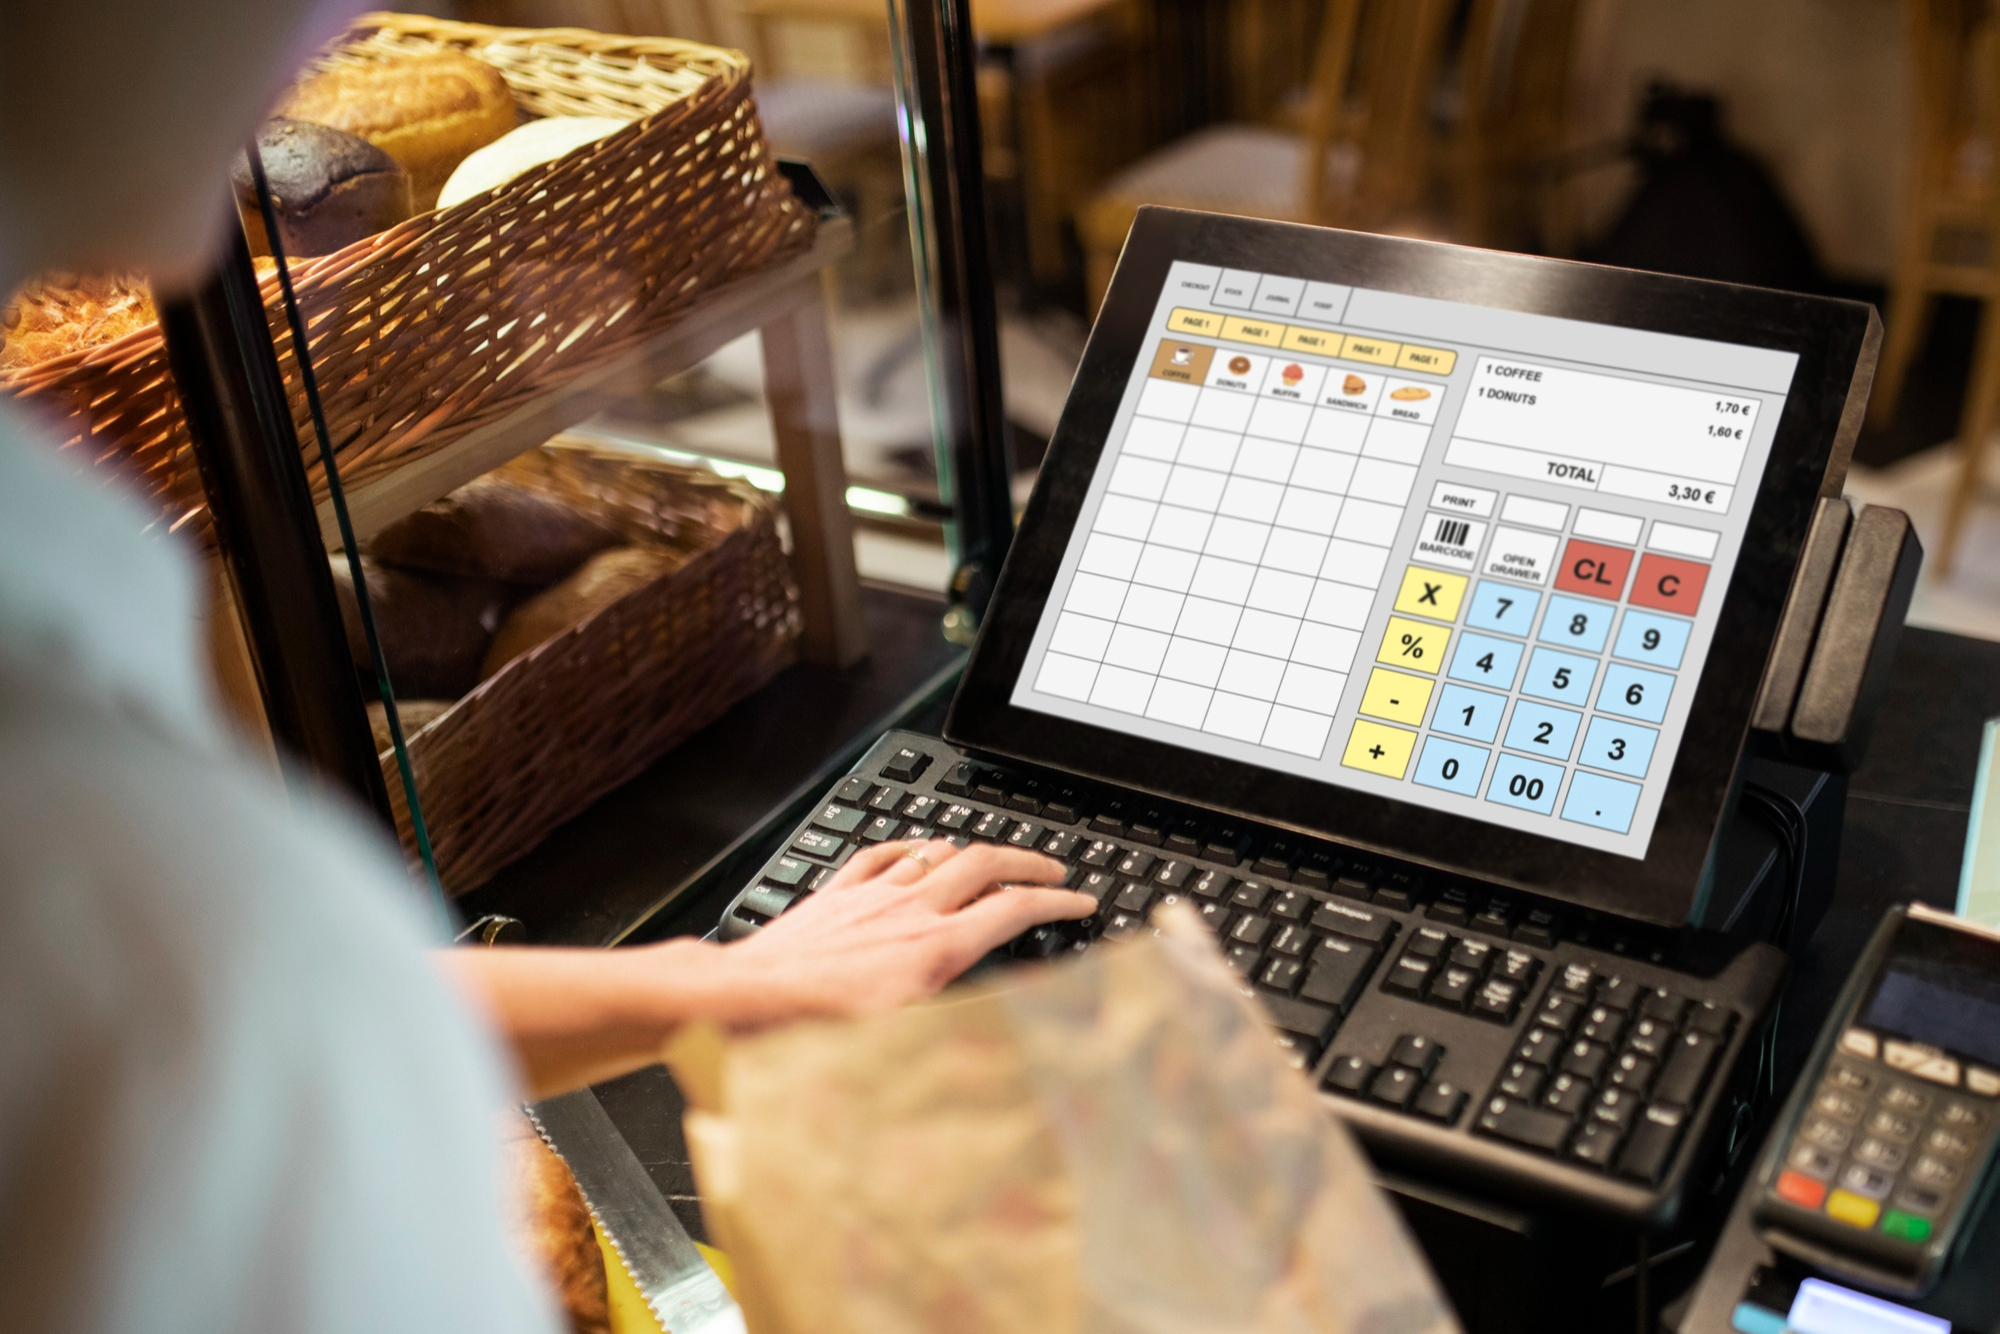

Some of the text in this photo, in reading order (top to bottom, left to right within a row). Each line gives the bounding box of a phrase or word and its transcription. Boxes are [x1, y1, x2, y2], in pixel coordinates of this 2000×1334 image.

[1181, 281, 1210, 290] CHECKOUT
[1224, 288, 1243, 296] STOCK
[1183, 317, 1210, 328] PAGE 1
[1242, 326, 1263, 336] PAGE
[1298, 335, 1326, 347] PAGE 1
[1353, 344, 1381, 356] PAGE 1
[1409, 353, 1439, 365] PAGE 1
[1162, 369, 1191, 380] COFFEE
[1487, 362, 1542, 382] 1 COFFEE
[1216, 379, 1247, 389] DONUTS
[1272, 388, 1300, 398] MUFFIN
[1479, 387, 1536, 405] 1 DONUTS
[1326, 397, 1367, 410] SANDWICH
[1716, 401, 1750, 415] 1,70 €
[1392, 409, 1420, 420] BREAD
[1708, 425, 1743, 439] 1,60 €
[1548, 462, 1595, 483] TOTAL
[1668, 484, 1715, 504] 3,30 €
[1442, 495, 1476, 508] PRINT
[1420, 542, 1474, 559] BARCODE
[1503, 554, 1536, 567] OPEN
[1490, 564, 1540, 582] DRAWER
[1573, 559, 1612, 585] CL
[1657, 575, 1680, 597] C
[1418, 582, 1441, 606] X
[1496, 598, 1513, 619] 7
[1569, 614, 1588, 636] 8
[1642, 629, 1661, 650] 9
[1401, 634, 1423, 659] %
[1476, 652, 1494, 673] 4
[1552, 667, 1571, 689] 5
[1625, 683, 1644, 705] 6
[1462, 705, 1475, 726] 1
[1533, 722, 1553, 745] 2
[901, 749, 914, 757] Esc
[1369, 744, 1385, 759] +
[1608, 738, 1626, 760] 3
[1442, 758, 1459, 780] 0
[1509, 774, 1544, 800] 00
[916, 797, 928, 806] @
[828, 805, 841, 814] Tab
[907, 805, 917, 813] 2
[876, 818, 886, 828] Q
[942, 814, 951, 822] 3
[985, 813, 994, 822] $
[911, 827, 924, 836] W
[978, 823, 987, 831] 4
[1021, 823, 1031, 832] %
[799, 837, 817, 846] Lock
[804, 831, 822, 842] Caps
[1012, 832, 1022, 841] 5
[1049, 841, 1058, 850] 6
[1094, 841, 1103, 850] &
[1086, 850, 1096, 859] 7
[780, 859, 798, 869] Shift
[1123, 861, 1132, 869] 8
[1089, 874, 1101, 884] U
[1161, 871, 1170, 879] 9
[755, 886, 770, 894] Ctrl
[1204, 905, 1215, 914] P
[1115, 916, 1127, 927] K
[1036, 931, 1047, 940] N
